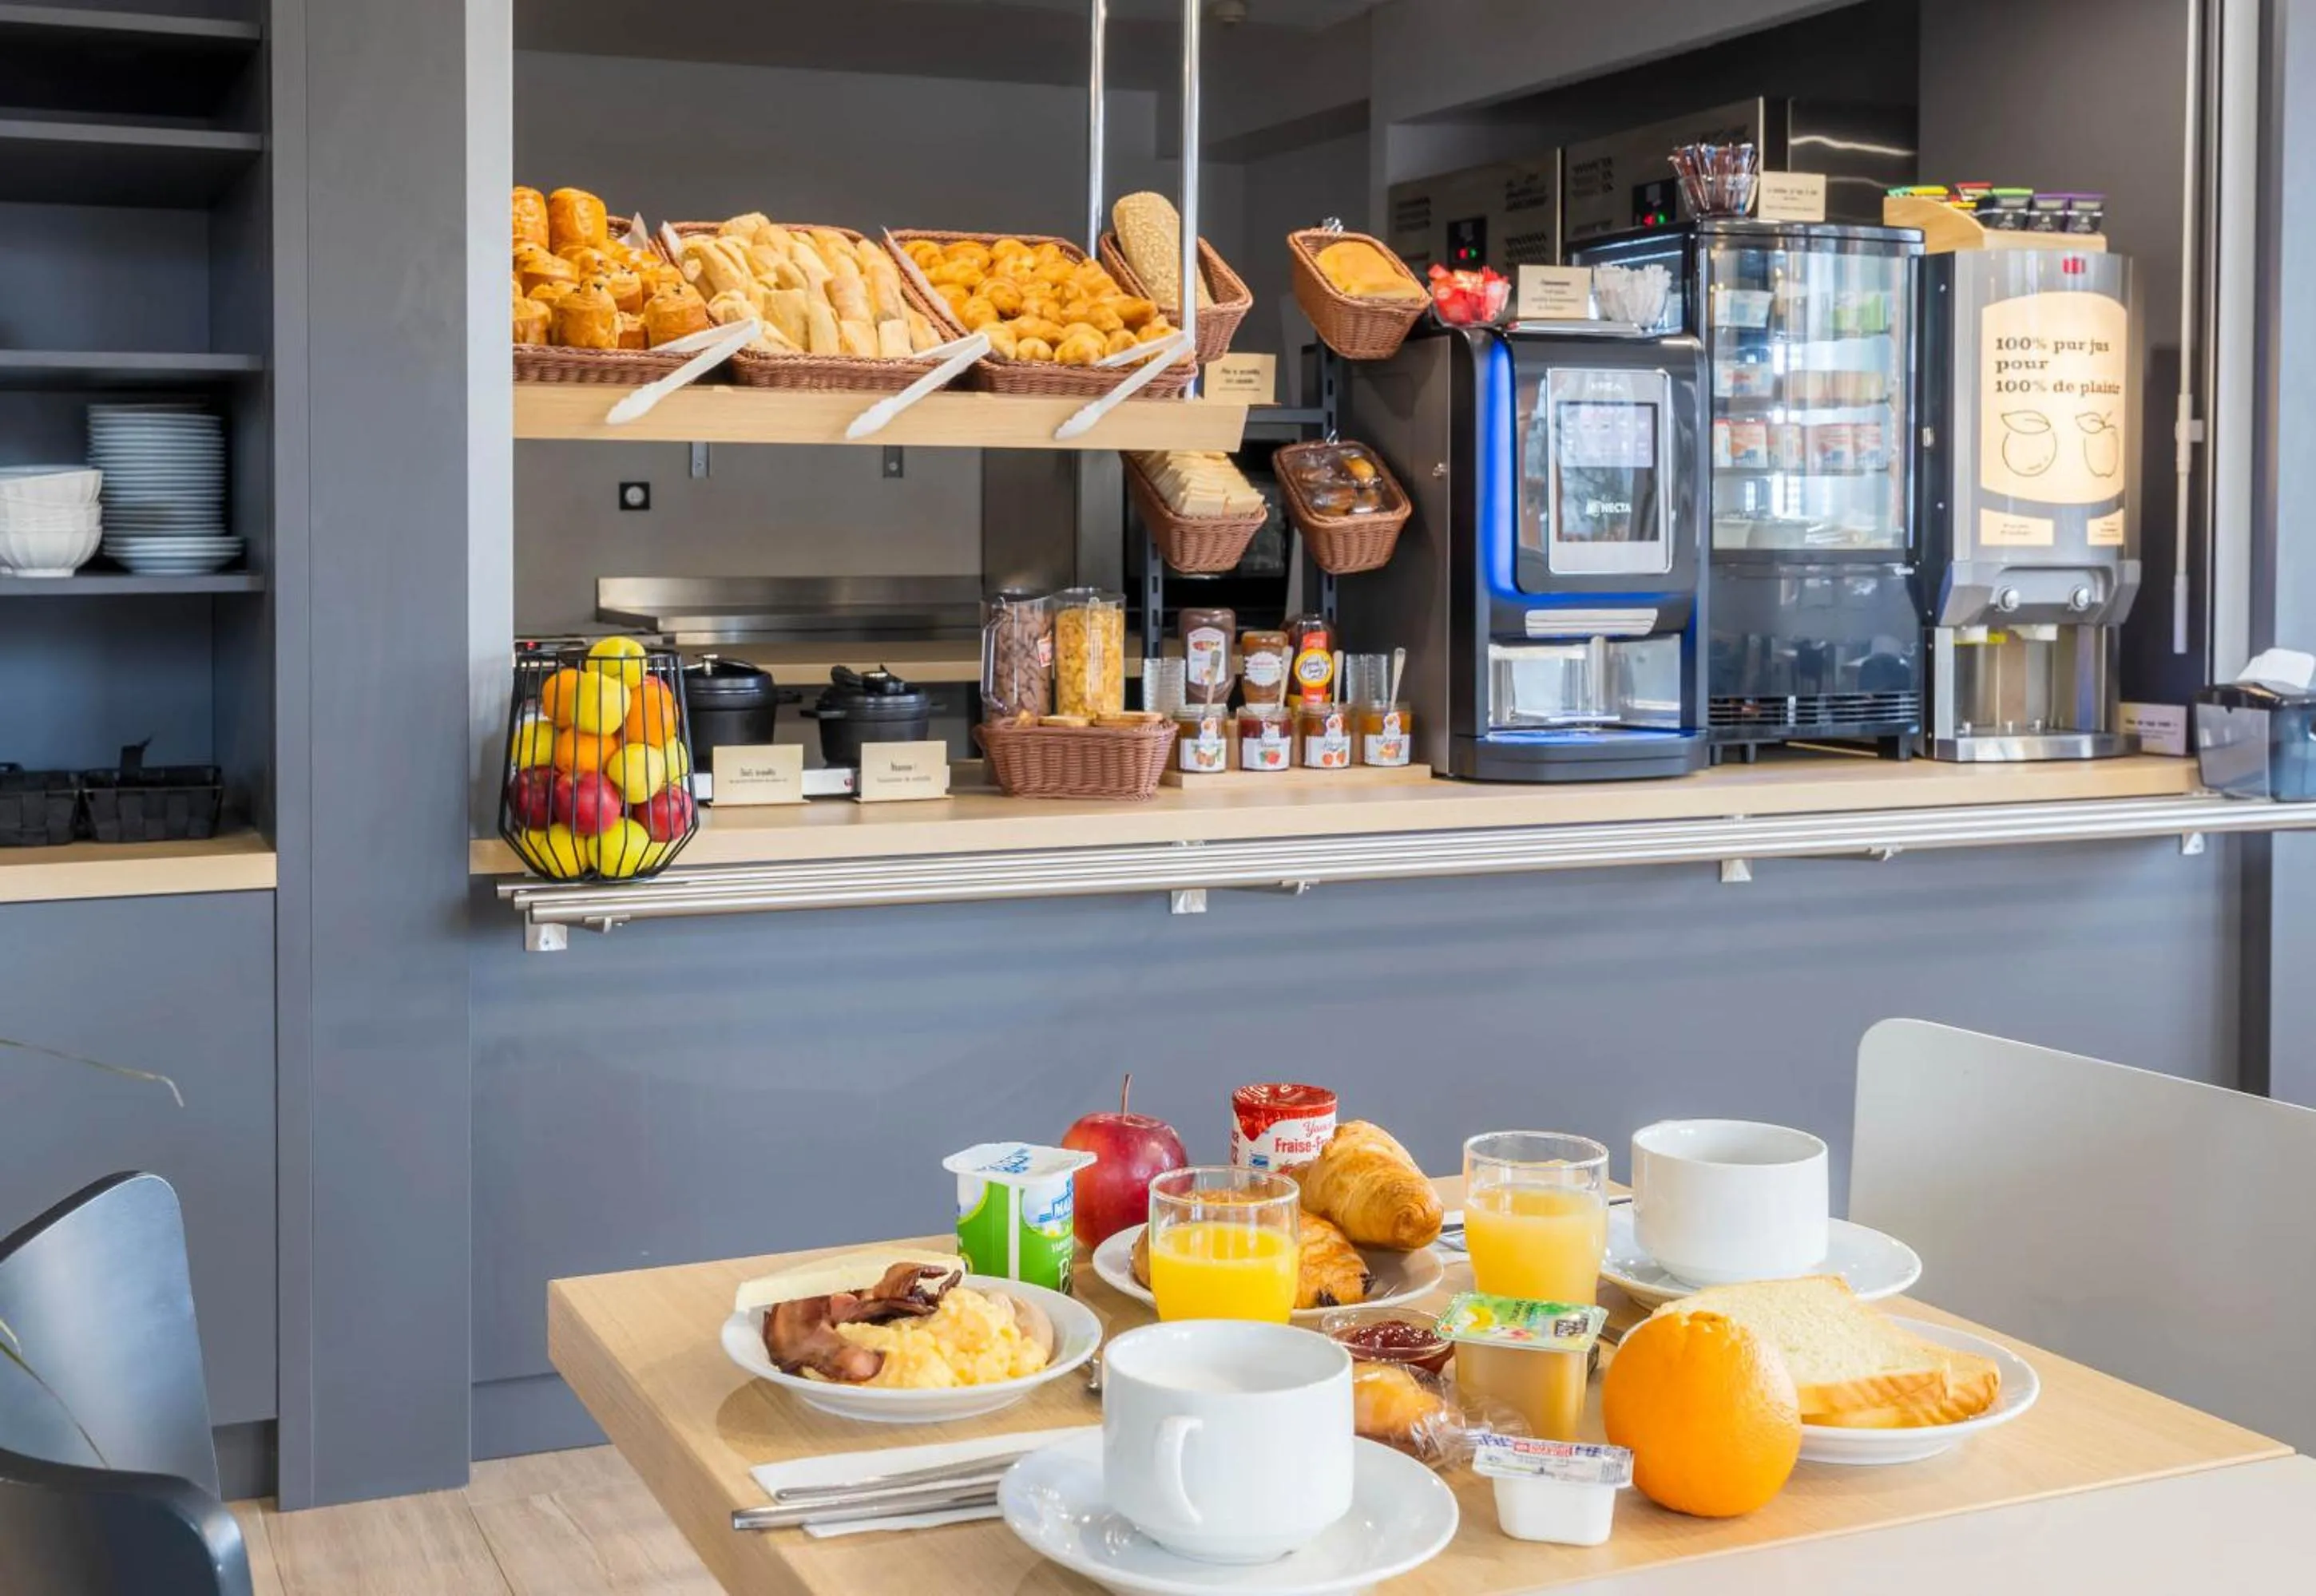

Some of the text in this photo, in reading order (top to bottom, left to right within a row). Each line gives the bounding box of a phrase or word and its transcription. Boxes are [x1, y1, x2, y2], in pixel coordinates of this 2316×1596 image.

[1995, 336, 2110, 355] 100% pur jus
[1995, 359, 2049, 374] pour
[1995, 379, 2048, 393] 100%
[2052, 379, 2075, 393] de
